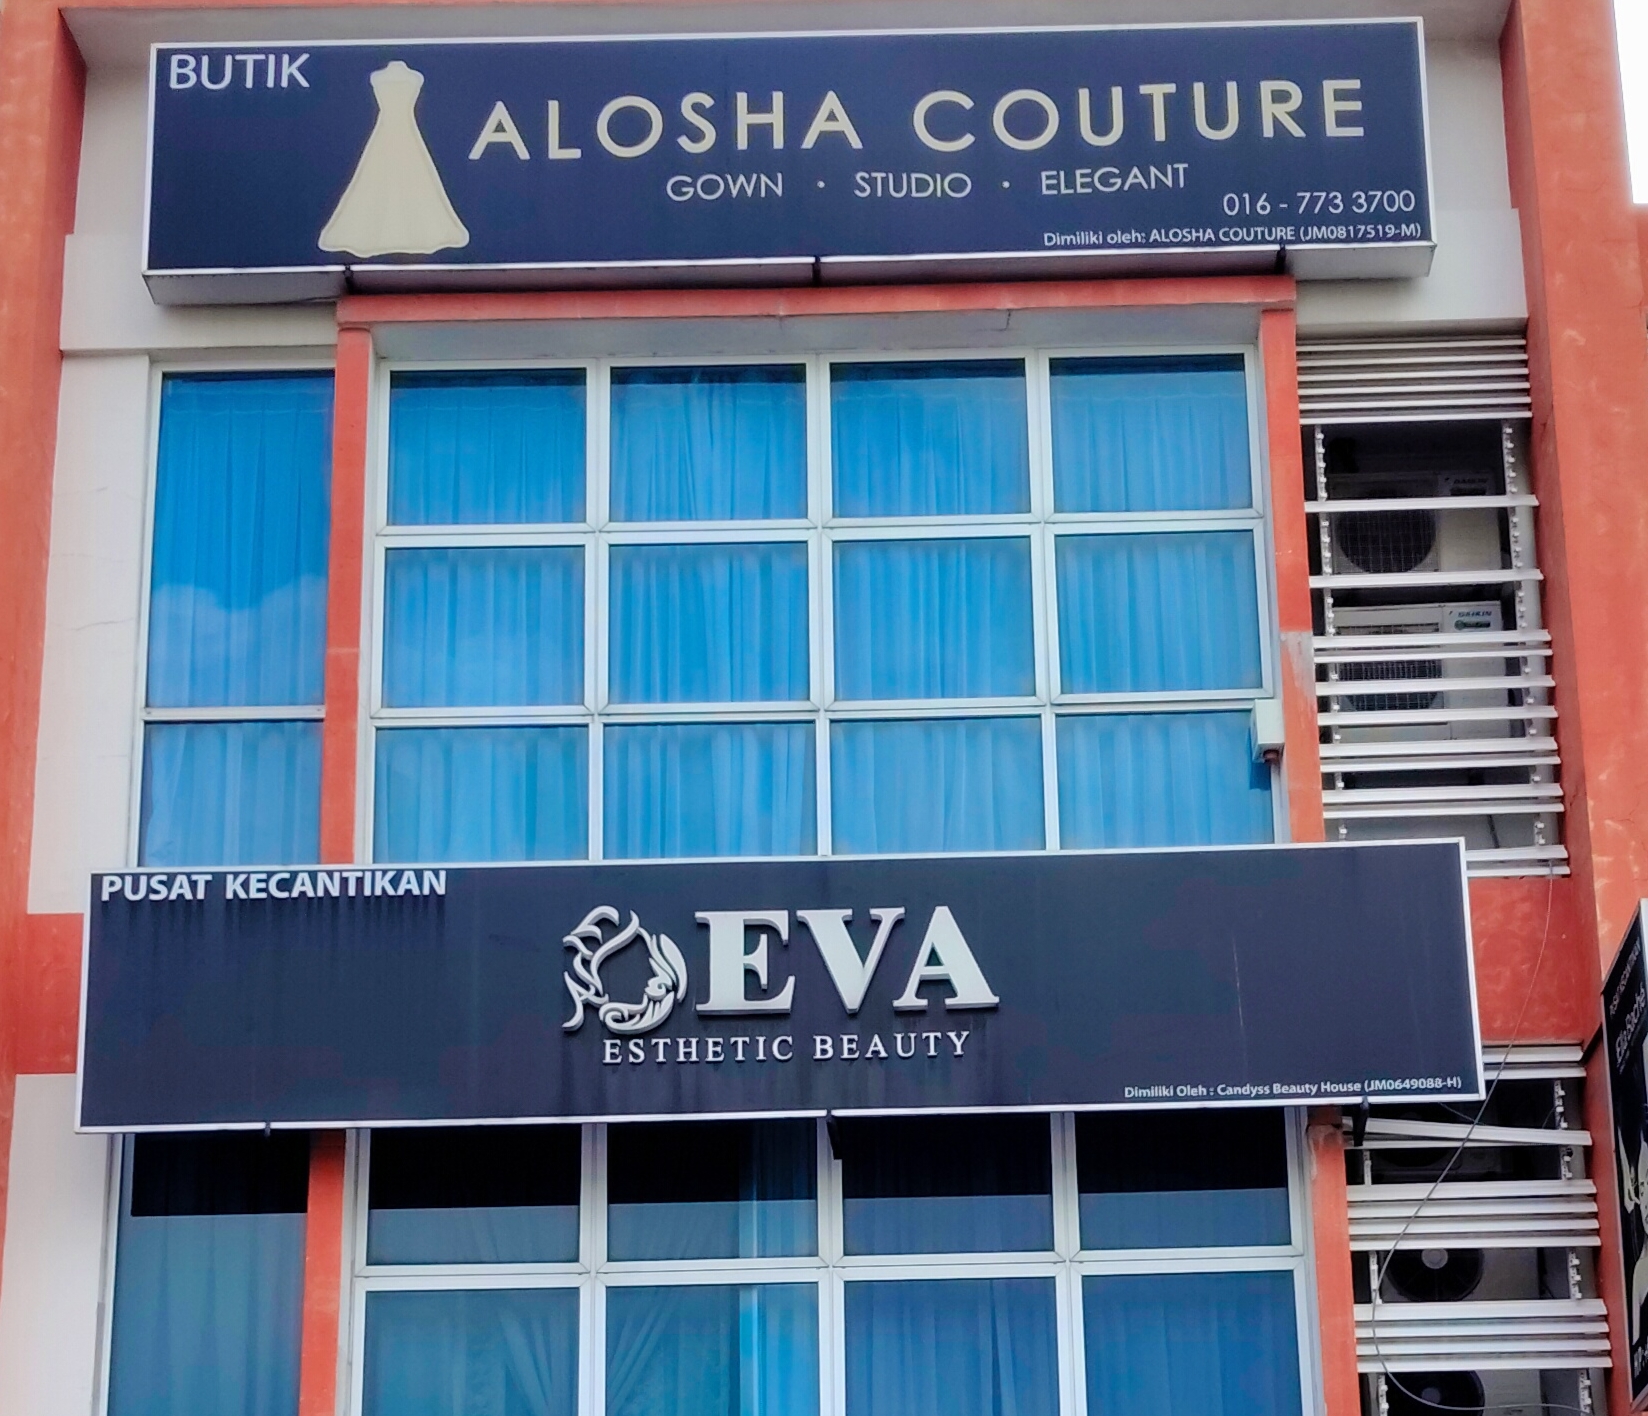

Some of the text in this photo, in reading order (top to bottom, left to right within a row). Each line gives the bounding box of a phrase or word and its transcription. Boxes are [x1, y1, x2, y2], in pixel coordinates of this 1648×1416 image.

[169, 53, 311, 90] BUTIK
[468, 79, 1365, 160] ALOSHA COUTURE
[666, 163, 1189, 202] GOWN STUDIO ELEGANT
[1223, 192, 1272, 216] 016
[1296, 191, 1344, 215] 773
[1352, 189, 1416, 213] 3700
[1044, 222, 1422, 247] Dimiliki oleh: ALOSHA COUTURE (JM0817519-M)
[100, 869, 447, 902] PUSAT KECANTIKAN
[602, 1030, 971, 1065] ESTHETIC BEAUTY
[1124, 1085, 1174, 1098] Dimiliki
[1176, 1084, 1207, 1098] Oleh
[1217, 1082, 1271, 1097] Candyss
[1272, 1081, 1318, 1096] Beauty
[1320, 1080, 1362, 1093] House
